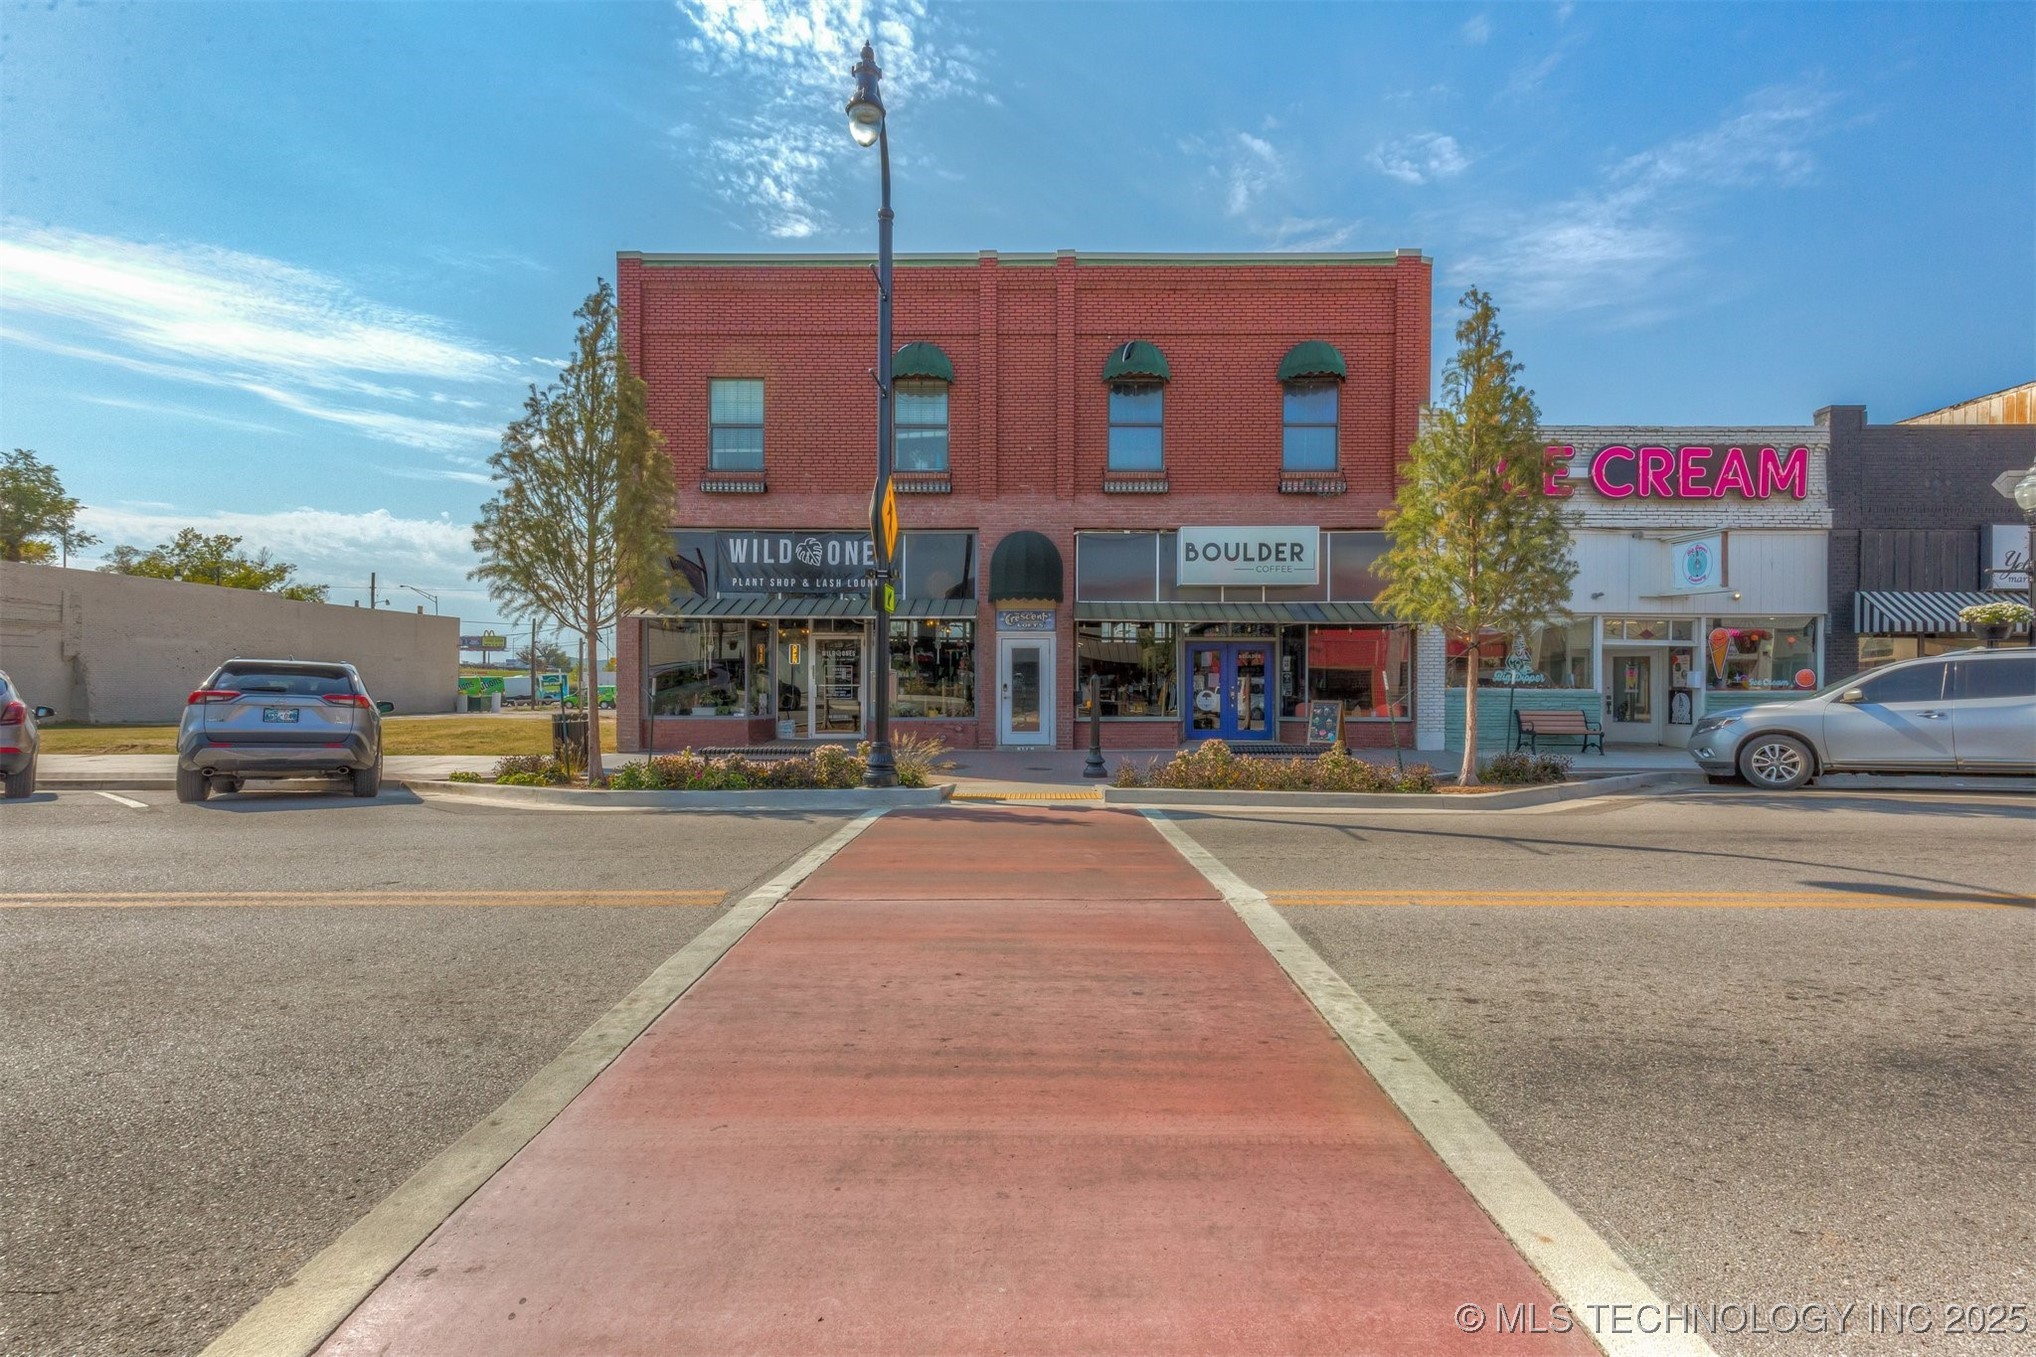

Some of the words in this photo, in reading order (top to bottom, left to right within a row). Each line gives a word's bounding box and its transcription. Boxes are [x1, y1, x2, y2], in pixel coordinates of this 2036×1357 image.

[1591, 444, 1811, 499] CREAM
[729, 538, 792, 564] WILD
[1185, 542, 1304, 562] BOULDER
[1255, 565, 1293, 573] COFFEE
[2000, 550, 2030, 580] Yel
[732, 578, 764, 587] PLANT
[770, 578, 796, 587] SHOP
[802, 579, 810, 588] &
[816, 579, 842, 588] LASH
[2008, 575, 2028, 583] mar
[1004, 611, 1049, 626] Crescent
[1492, 670, 1511, 685] Big
[1514, 671, 1545, 684] Dipper
